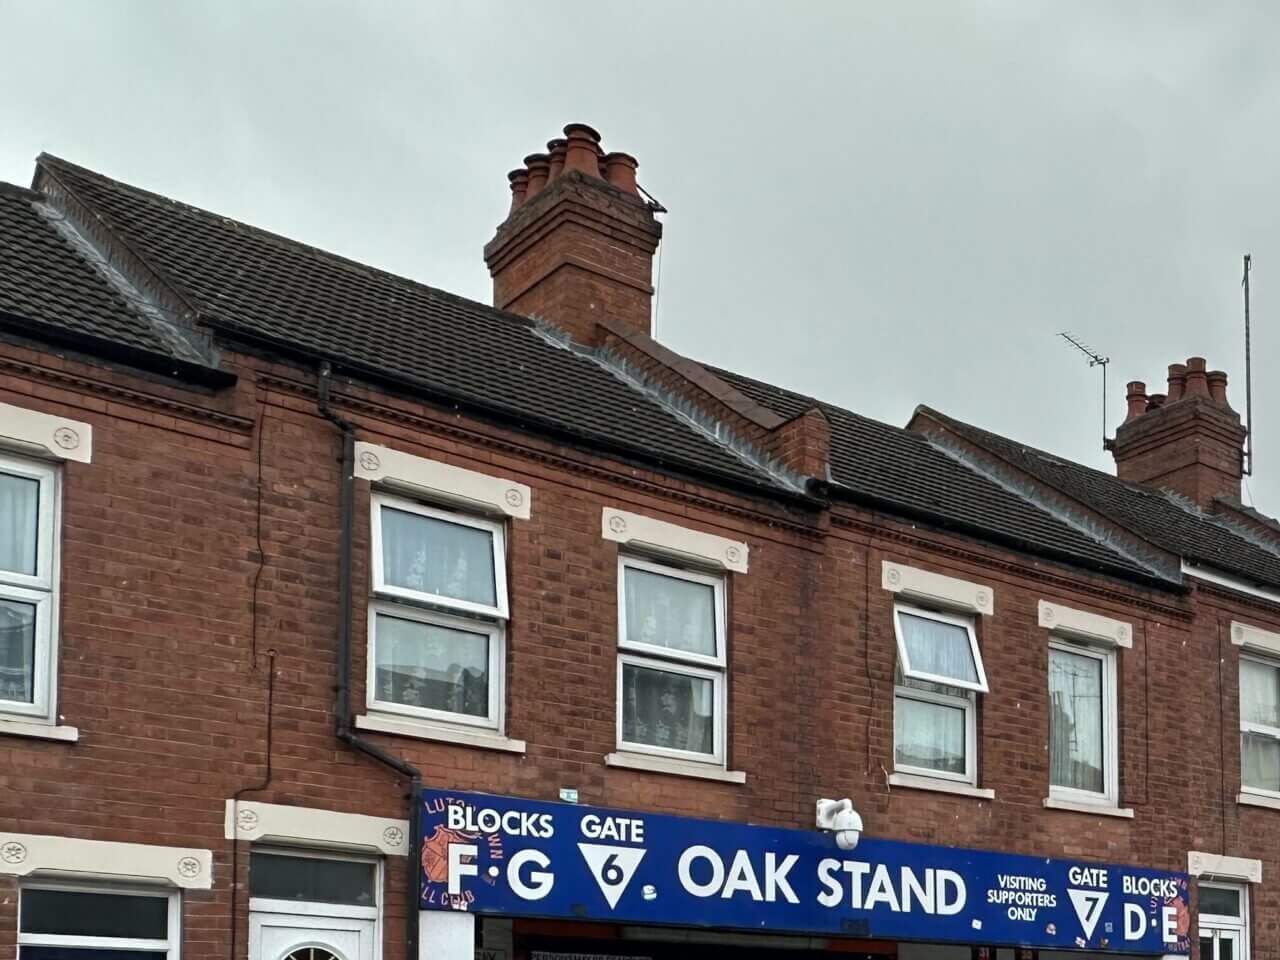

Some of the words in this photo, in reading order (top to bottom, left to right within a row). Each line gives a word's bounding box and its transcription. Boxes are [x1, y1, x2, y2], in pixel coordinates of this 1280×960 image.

[447, 805, 554, 838] BLOCKS
[580, 814, 644, 842] GATE
[601, 854, 624, 886] 6
[678, 845, 800, 904] OAK
[817, 858, 967, 915] STAND
[1069, 866, 1108, 888] GATE
[997, 874, 1046, 892] VISITING
[1122, 876, 1178, 898] BLOCKS
[987, 890, 1057, 907] SUPPORTERS
[1085, 897, 1100, 922] 7
[1007, 907, 1038, 921] ONLY
